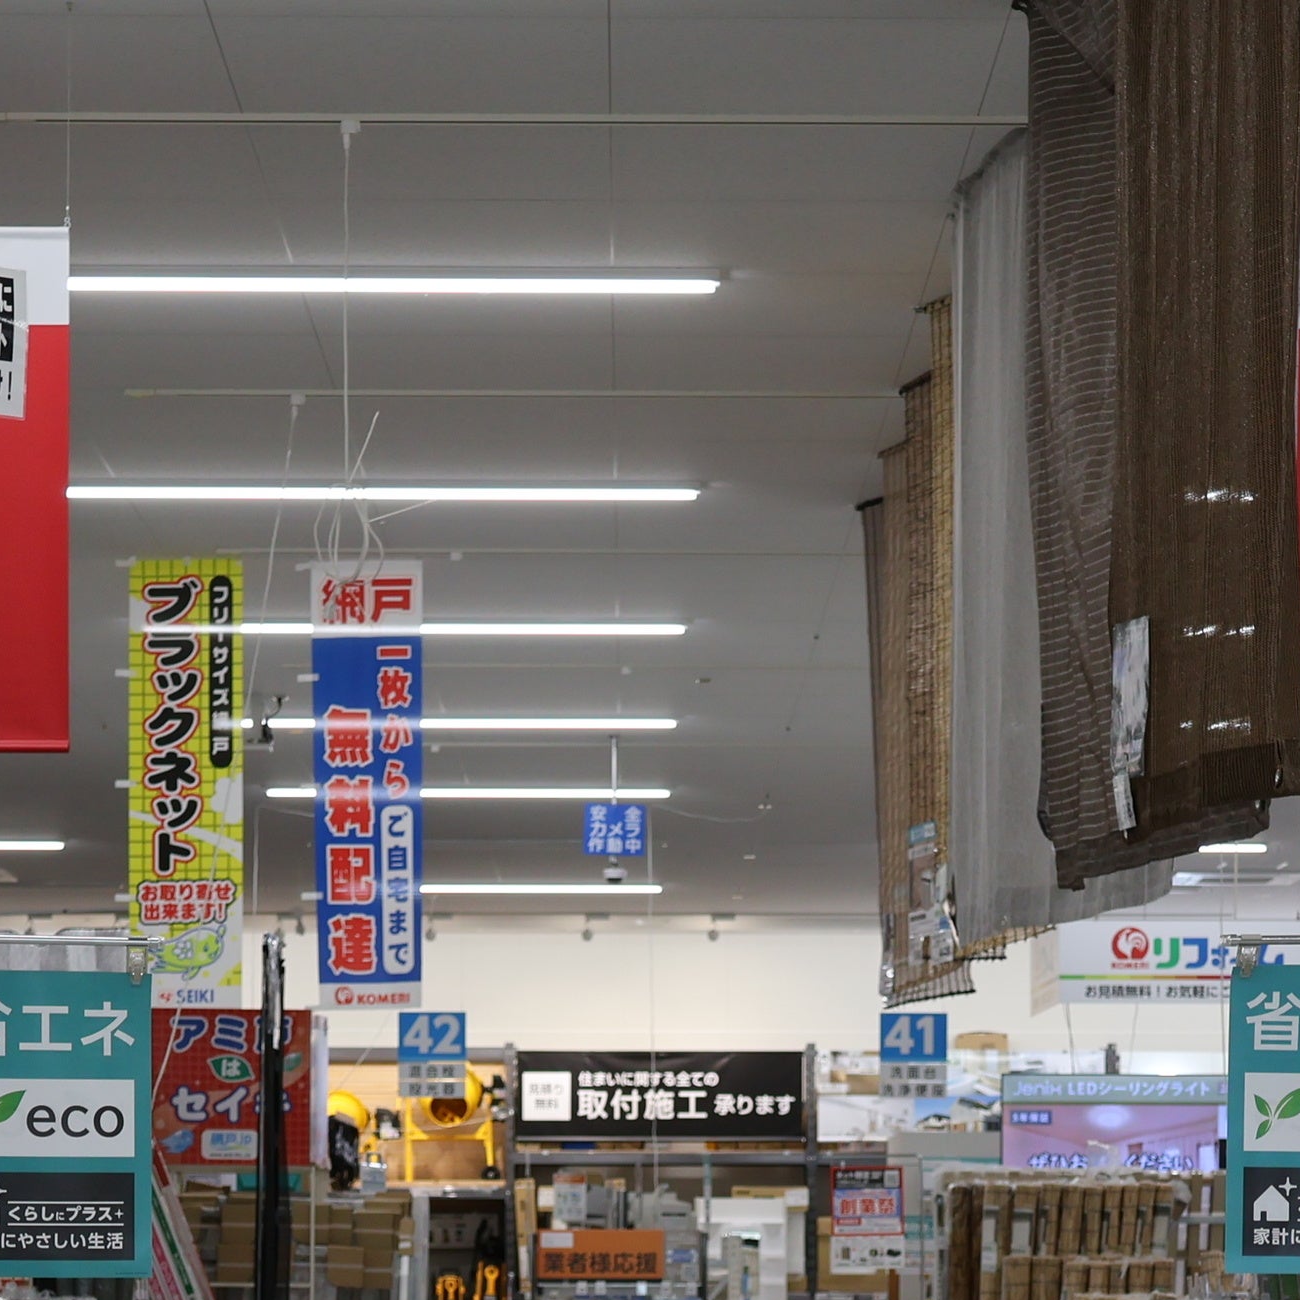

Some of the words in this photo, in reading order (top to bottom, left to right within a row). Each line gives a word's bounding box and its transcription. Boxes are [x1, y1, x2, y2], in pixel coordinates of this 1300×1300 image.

[177, 990, 215, 1004] SEIKI
[357, 993, 411, 1005] KOMERI
[403, 1014, 461, 1054] 42
[884, 1016, 937, 1056] 41
[221, 1058, 241, 1078] は
[26, 1104, 125, 1138] eco
